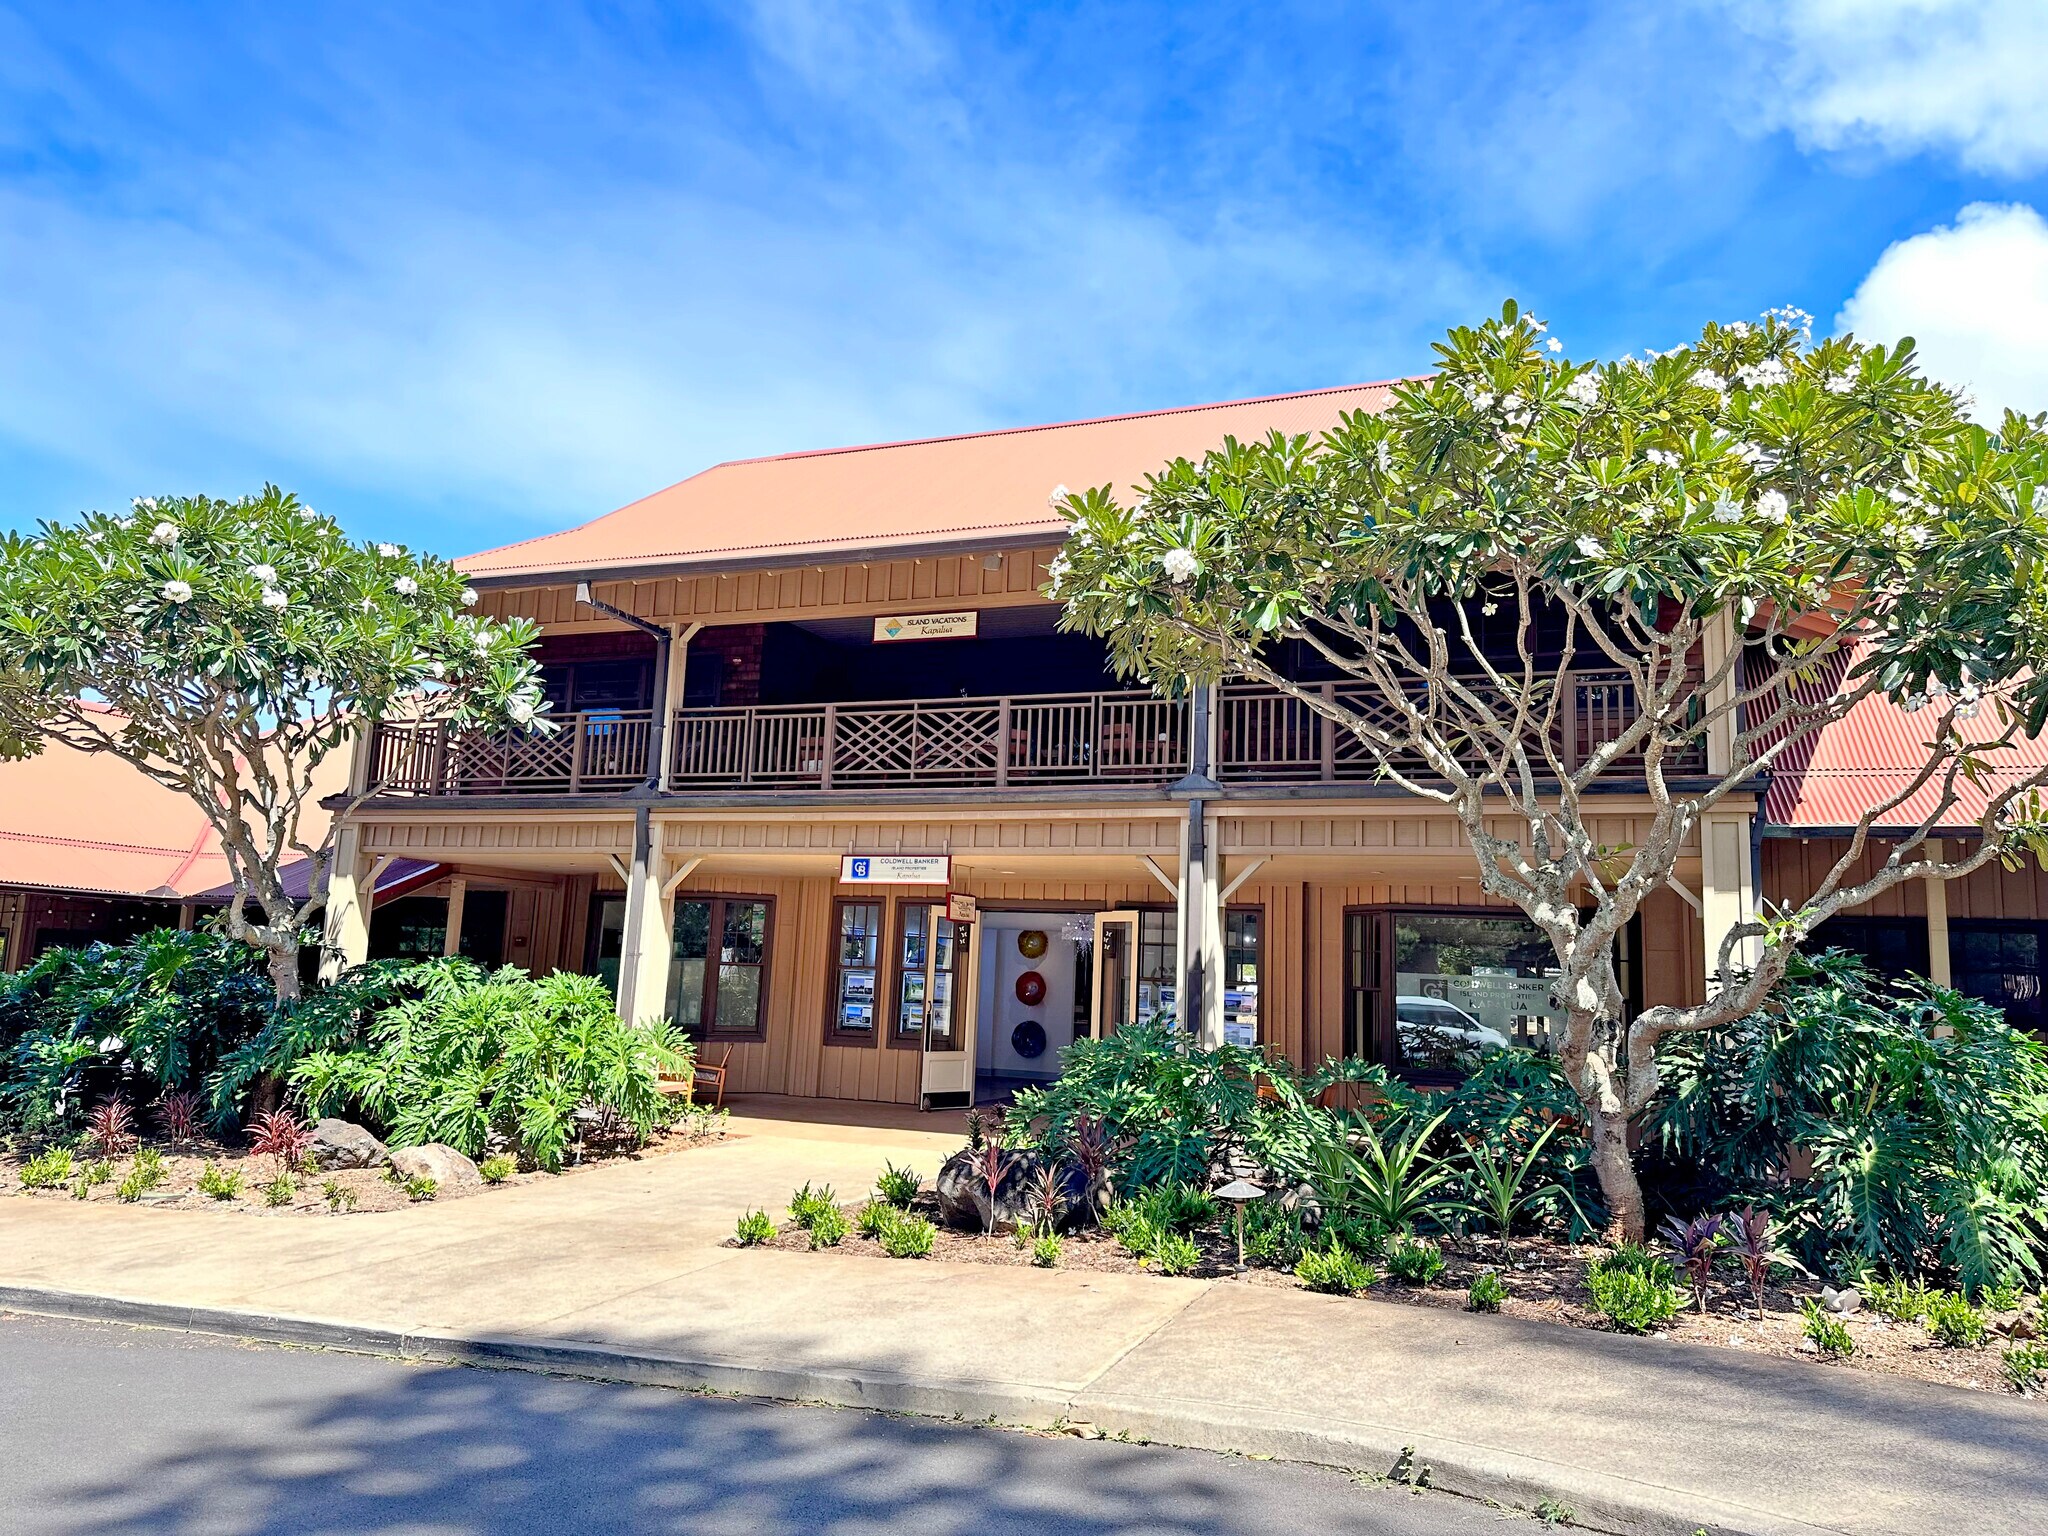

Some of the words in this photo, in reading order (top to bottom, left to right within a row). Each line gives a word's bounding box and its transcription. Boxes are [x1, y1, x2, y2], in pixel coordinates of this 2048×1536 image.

[907, 618, 930, 626] ISLAND
[931, 616, 967, 625] VACATIONS
[920, 625, 953, 636] Kapalua
[1453, 980, 1503, 990] COLDWELL
[1507, 982, 1545, 992] BANKER
